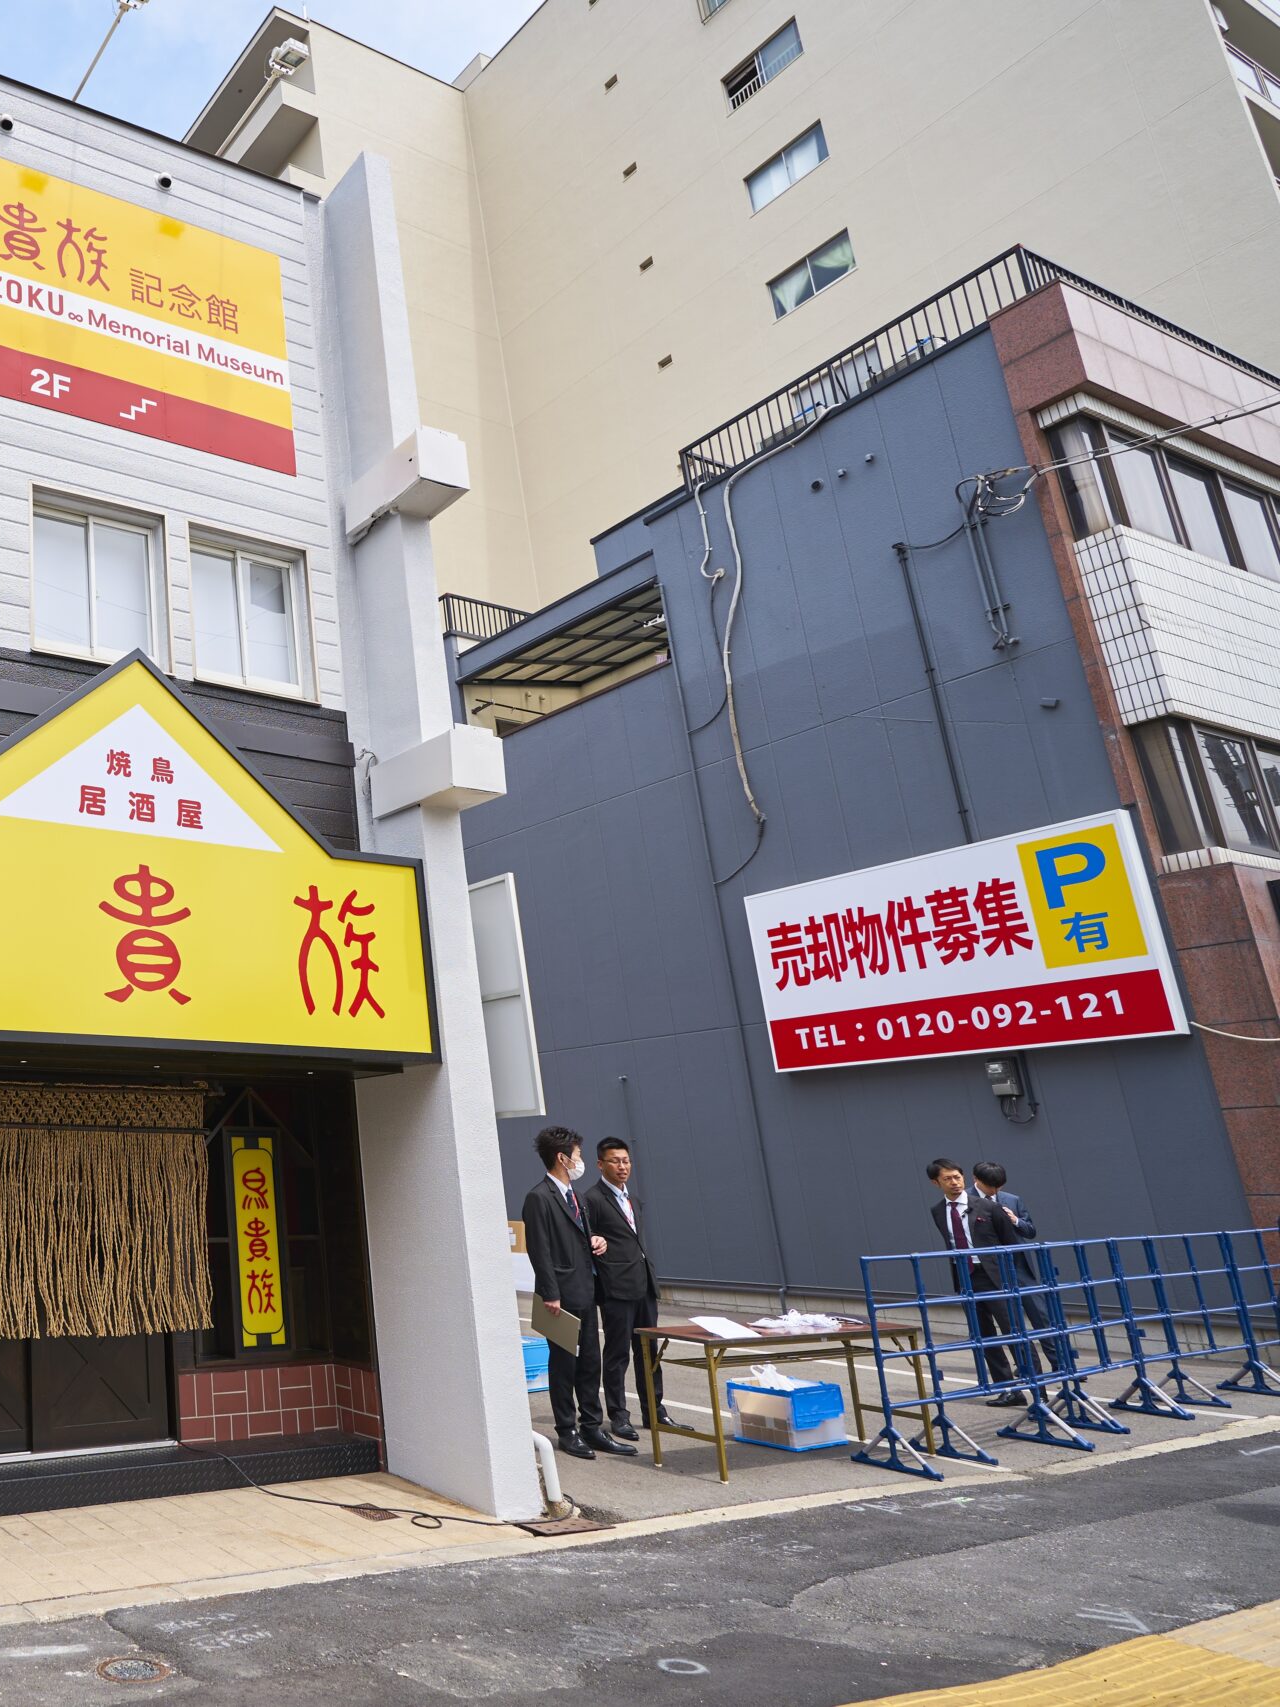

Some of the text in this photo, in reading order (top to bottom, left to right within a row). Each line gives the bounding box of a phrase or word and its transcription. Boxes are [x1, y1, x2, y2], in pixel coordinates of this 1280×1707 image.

[130, 267, 239, 334] 記念館
[88, 307, 190, 356] Memorial
[197, 343, 285, 386] Museum
[30, 368, 71, 399] 2F
[105, 749, 175, 786] 焼鳥
[78, 785, 204, 830] 居酒屋
[1035, 842, 1107, 910] P
[767, 878, 1034, 992] 売却物件募集
[1060, 911, 1110, 953] 有
[876, 989, 1125, 1041] 0120-092-121
[242, 1167, 276, 1314] 鳥貴族
